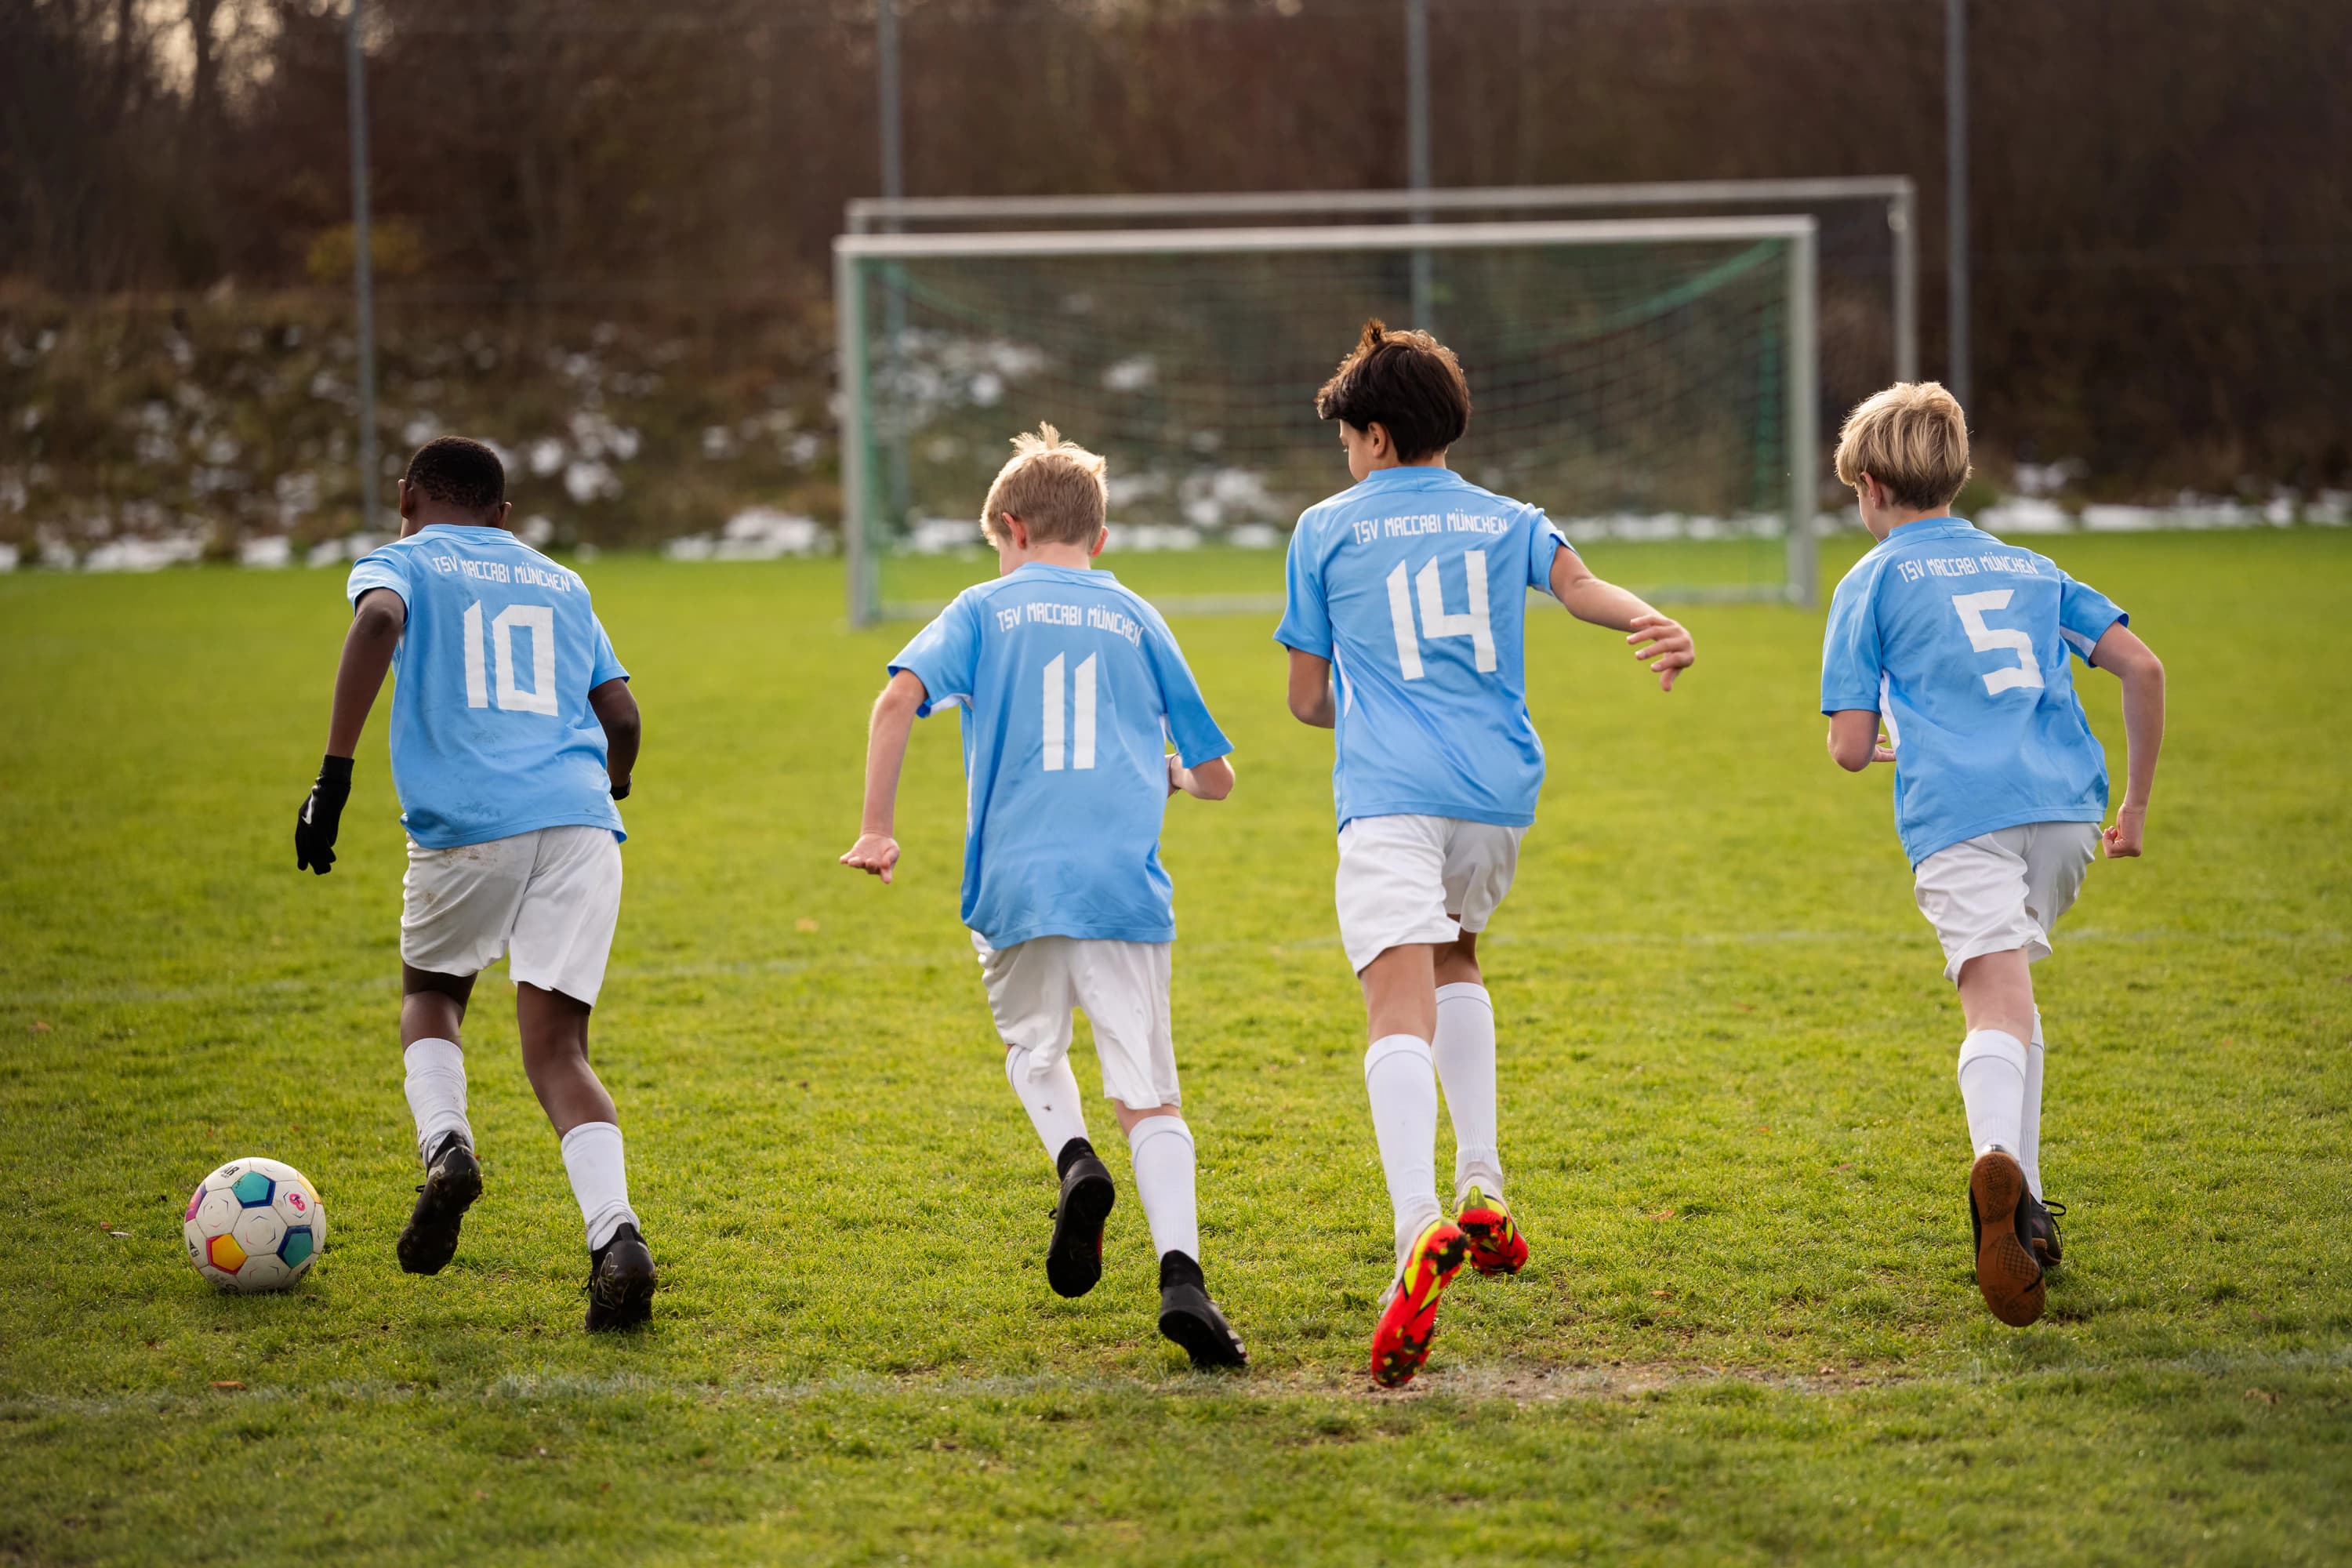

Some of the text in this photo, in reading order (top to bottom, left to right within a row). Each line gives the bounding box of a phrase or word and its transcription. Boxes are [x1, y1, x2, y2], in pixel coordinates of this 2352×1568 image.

[1352, 508, 1508, 545] TSV MACCABI MÜNCHEN
[433, 555, 571, 592] TSV MACCABI MÜNCHEN
[1897, 552, 2038, 583] TSV MACCABI MÜNCHEN
[996, 602, 1144, 648] TSV MACCABI MÜNCHEN
[1386, 550, 1497, 681] 14
[1951, 590, 2045, 696] 5
[463, 599, 558, 717] 10
[1043, 652, 1096, 771] 11
